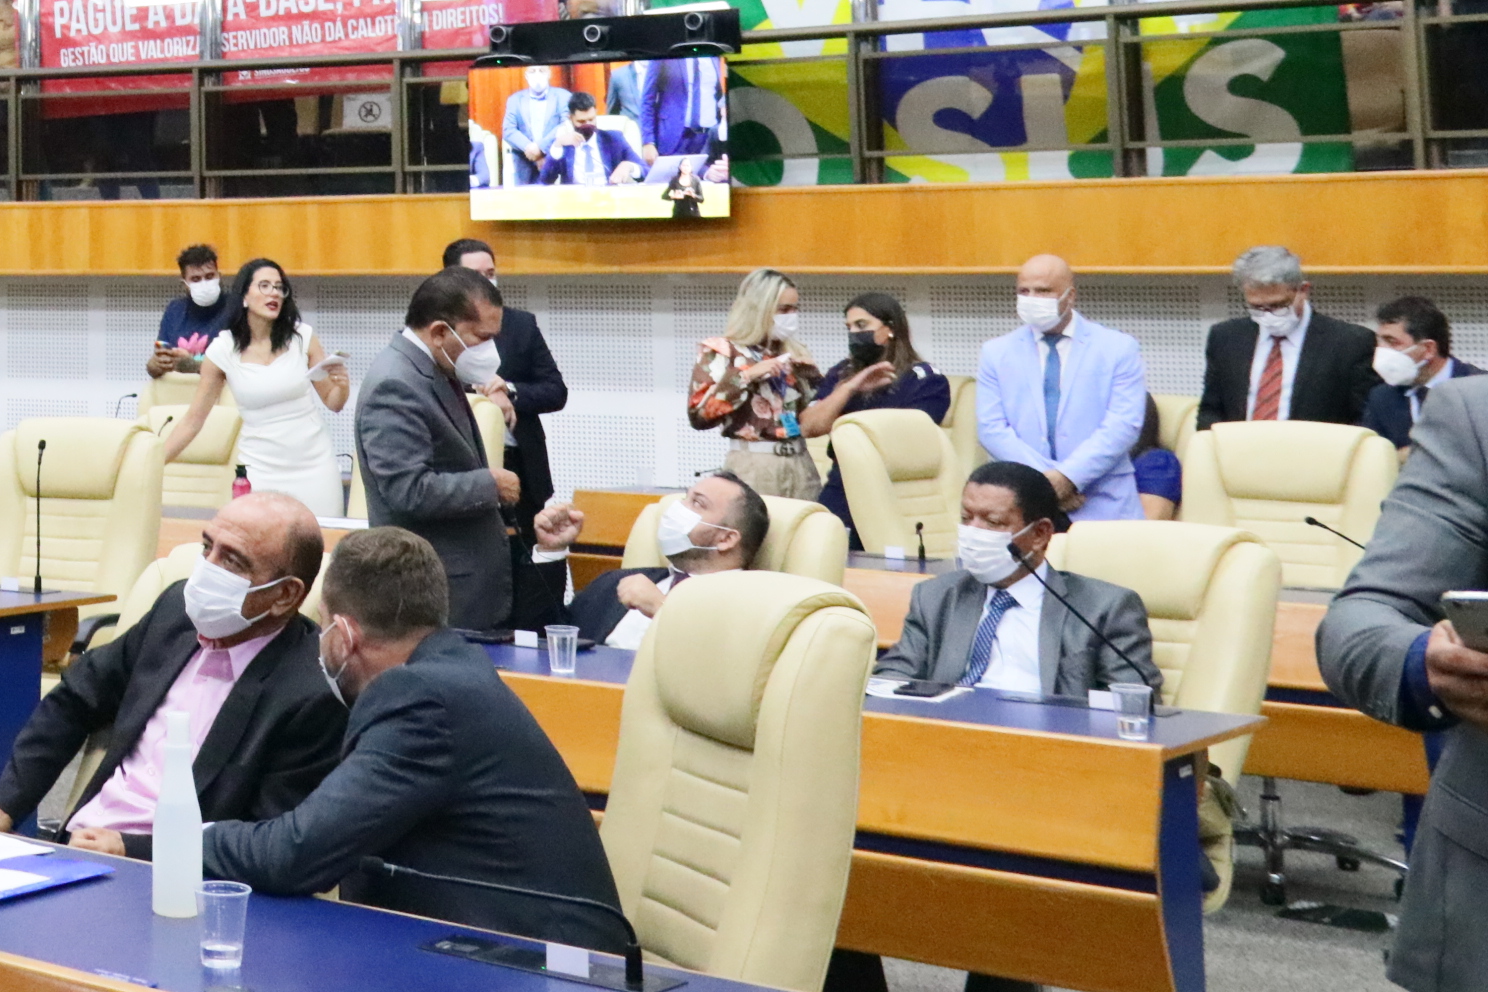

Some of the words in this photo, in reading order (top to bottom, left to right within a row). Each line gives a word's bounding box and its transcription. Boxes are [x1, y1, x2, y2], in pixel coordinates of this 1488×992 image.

[60, 43, 107, 68] GESTÃO
[110, 40, 135, 62] QUE
[221, 25, 288, 52] SERVIDOR
[291, 20, 322, 45] NÃO
[325, 17, 344, 41] DÁ
[432, 3, 504, 30] DIREITOS!
